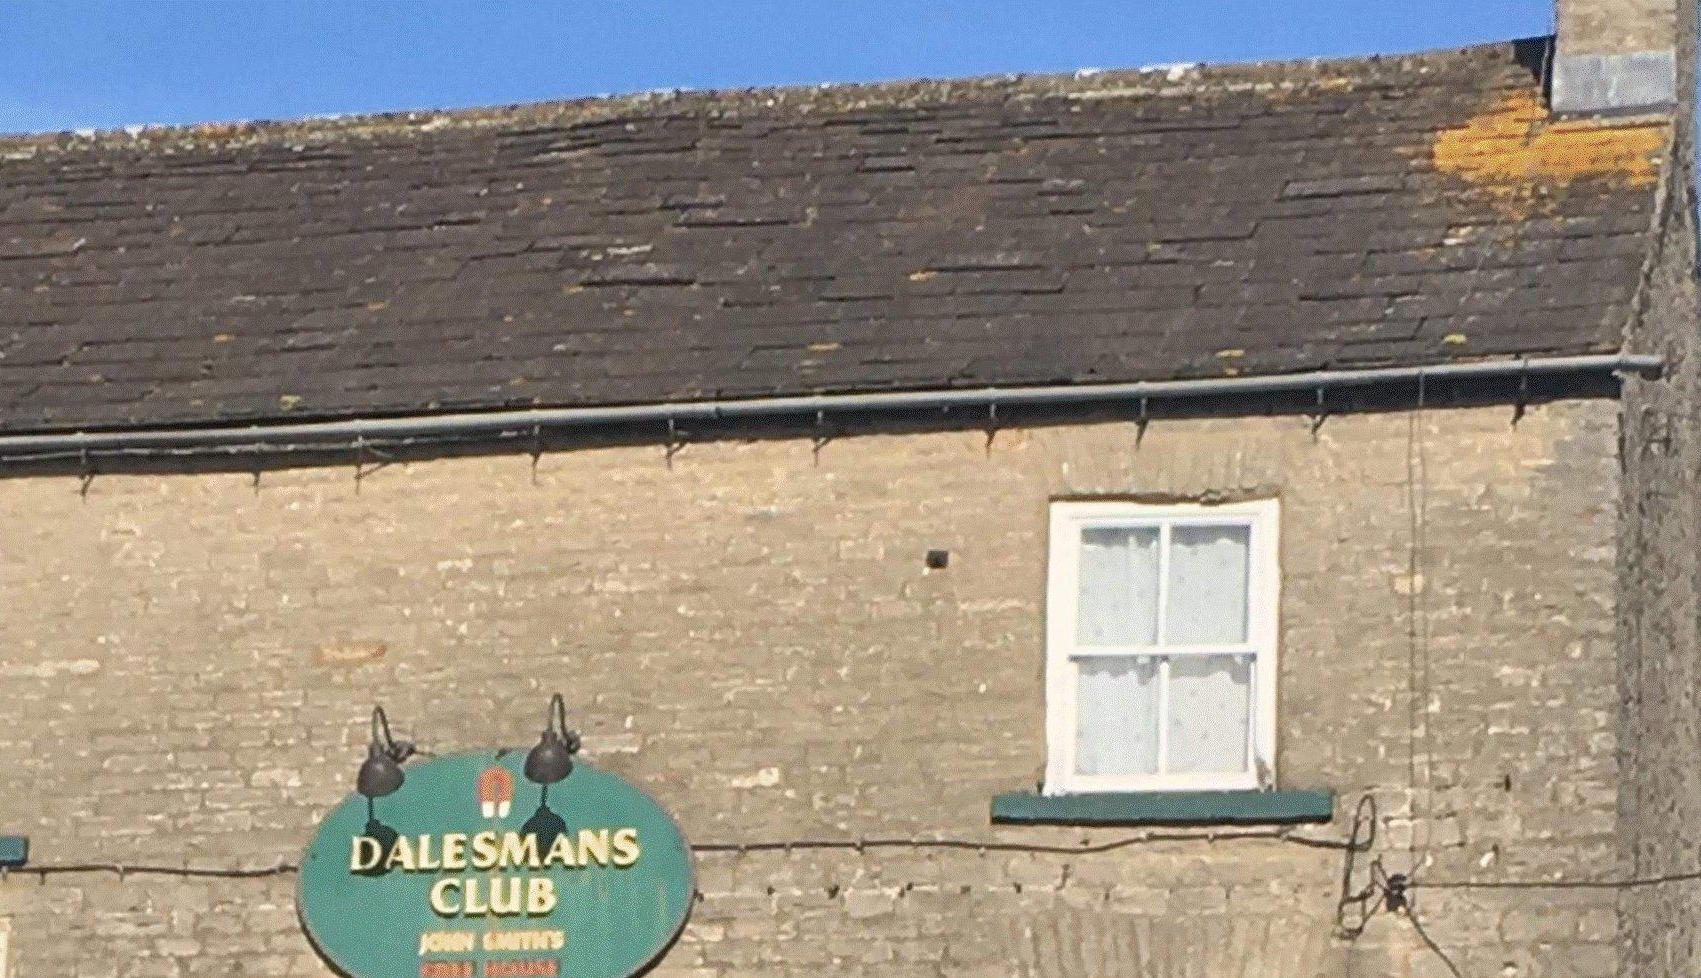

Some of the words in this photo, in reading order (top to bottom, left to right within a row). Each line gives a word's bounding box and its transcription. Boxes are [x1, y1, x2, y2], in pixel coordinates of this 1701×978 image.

[350, 828, 641, 872] DALESMANS
[430, 876, 558, 916] CLUB
[418, 931, 476, 955] JOHN
